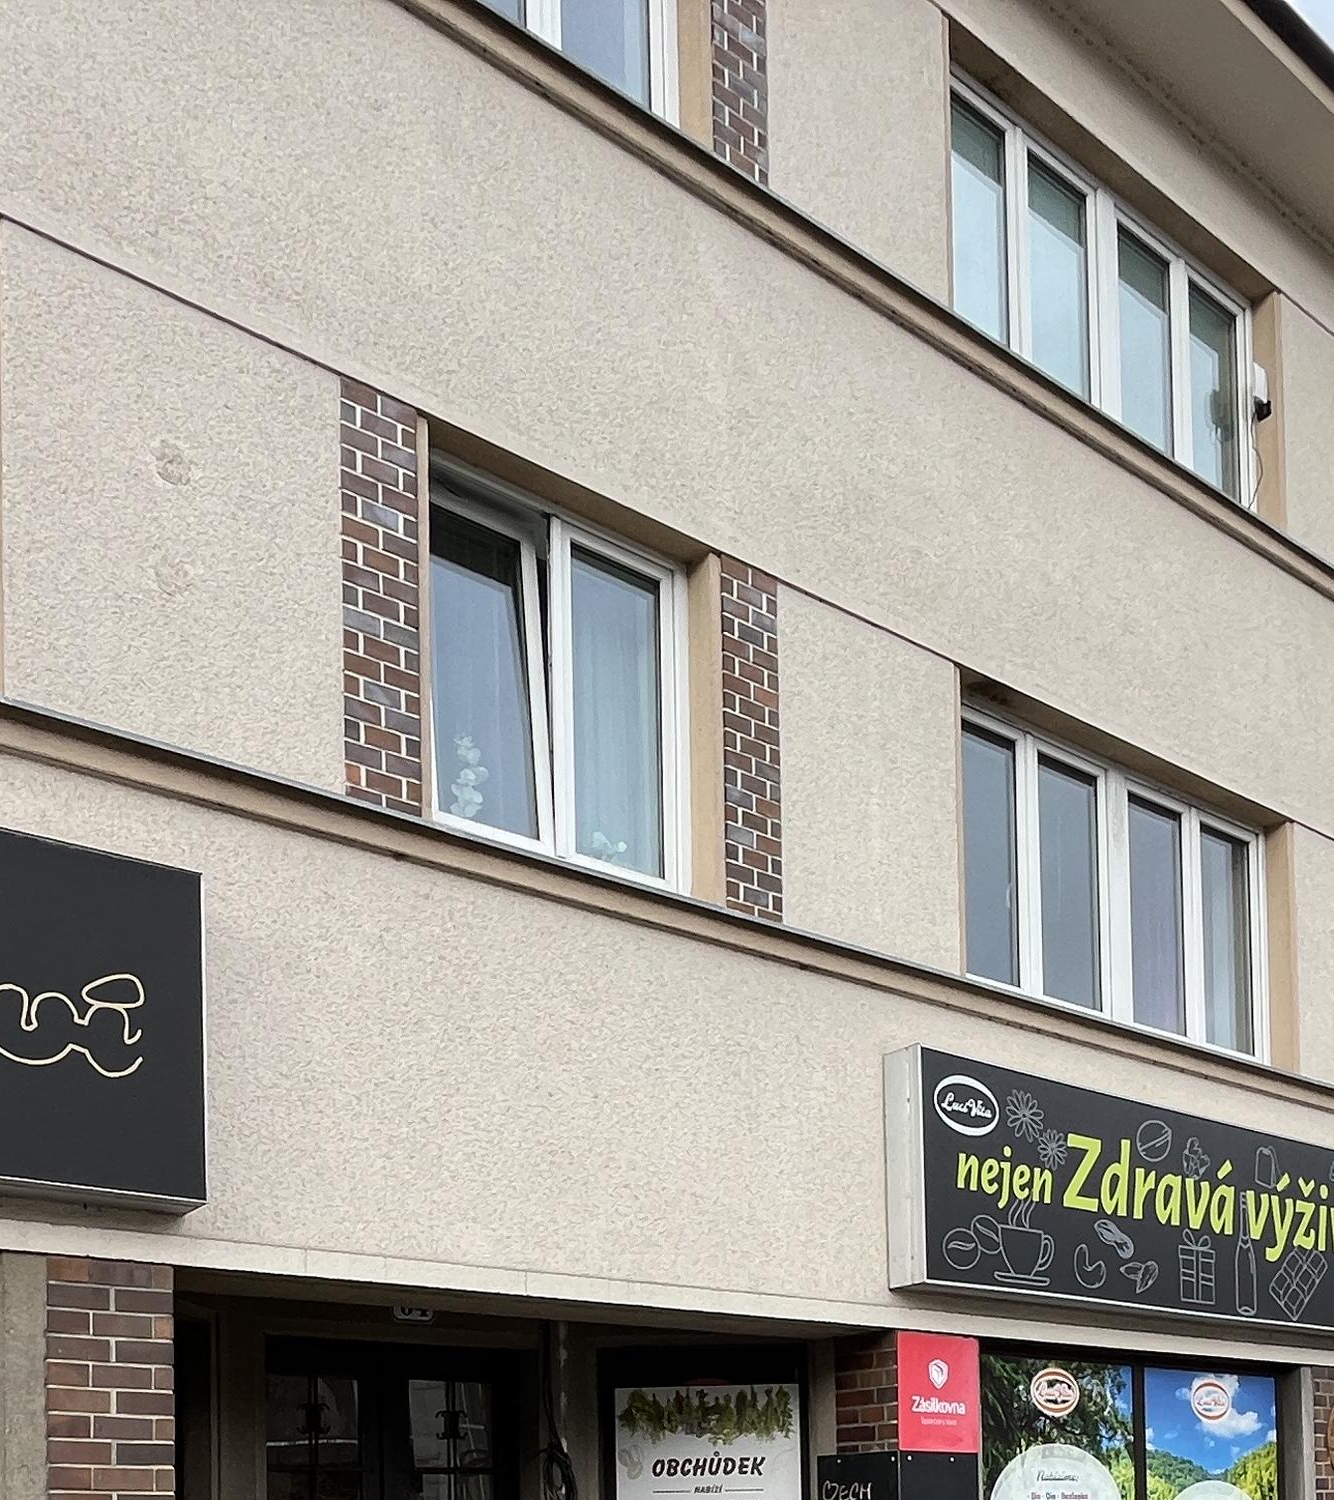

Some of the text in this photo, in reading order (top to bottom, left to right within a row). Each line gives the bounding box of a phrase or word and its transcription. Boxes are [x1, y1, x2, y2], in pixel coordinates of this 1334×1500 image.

[955, 1145, 1054, 1208] nejen
[1062, 1133, 1235, 1235] Zdravá
[911, 1395, 966, 1415] Zásilkovna
[651, 1450, 766, 1478] OBCHŮDEK
